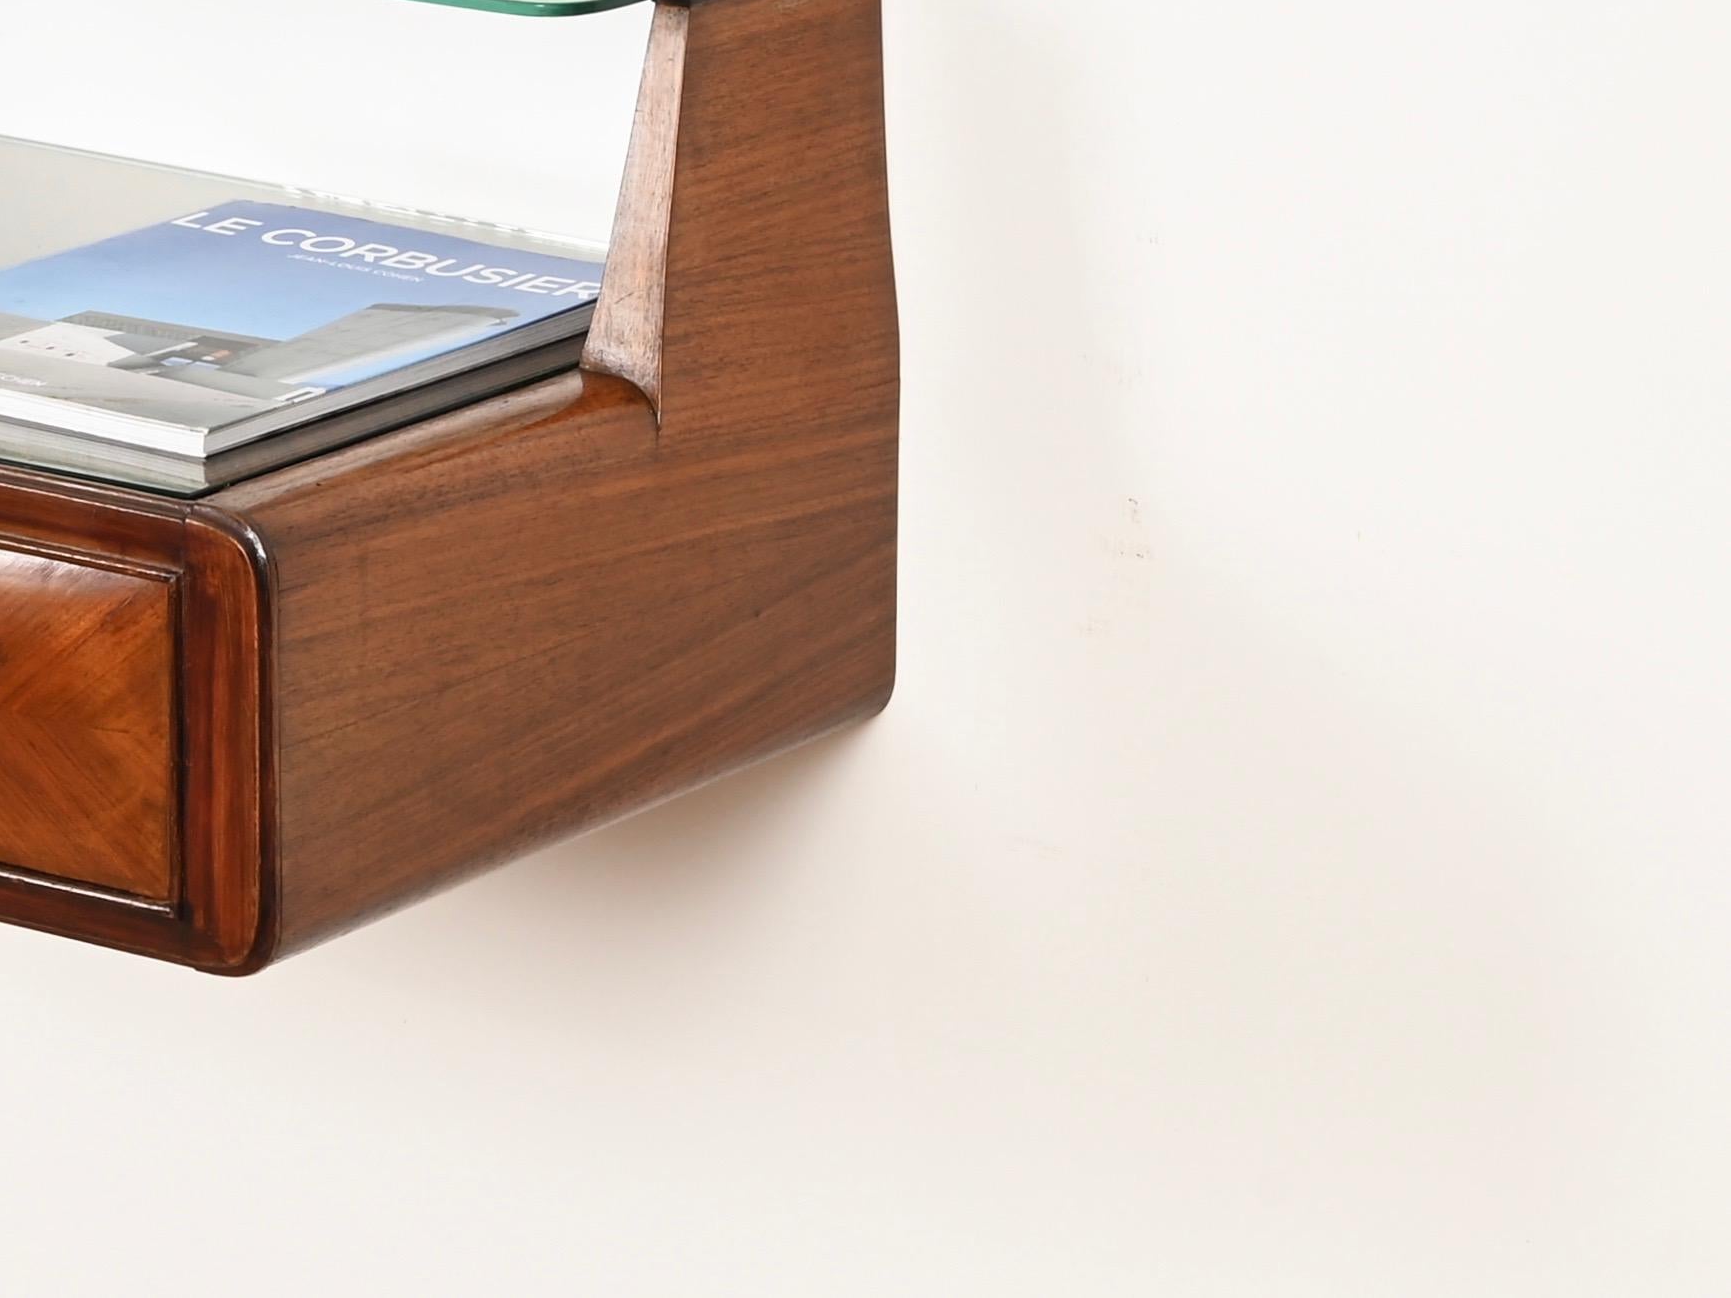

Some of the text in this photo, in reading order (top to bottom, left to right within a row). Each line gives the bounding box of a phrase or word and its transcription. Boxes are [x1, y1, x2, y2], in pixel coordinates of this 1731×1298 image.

[171, 211, 602, 300] LE CORBUSIER
[373, 269, 425, 283] COHEN
